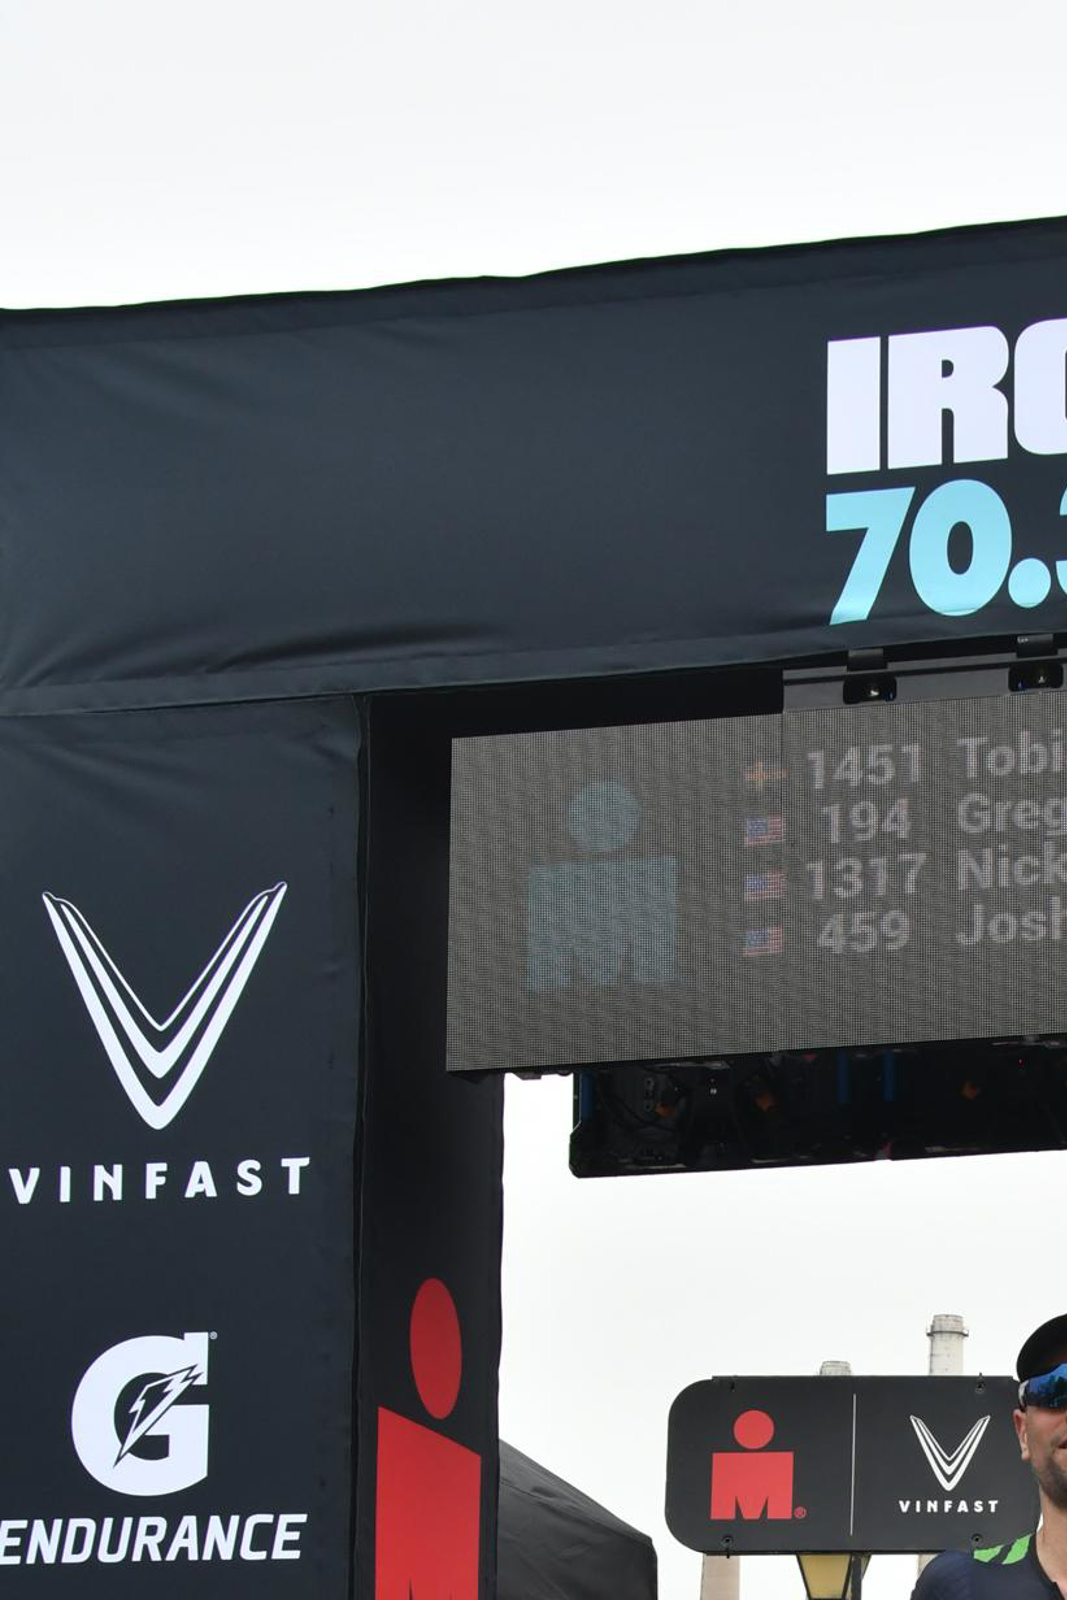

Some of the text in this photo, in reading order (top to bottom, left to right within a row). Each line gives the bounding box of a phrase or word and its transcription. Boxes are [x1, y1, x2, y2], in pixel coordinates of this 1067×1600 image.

[807, 742, 921, 790] 1451
[822, 798, 911, 844] 194
[806, 852, 927, 900] 1317
[817, 910, 911, 953] 459
[9, 1156, 310, 1204] VINFAST
[898, 1499, 999, 1513] VINFAST
[0, 1512, 308, 1565] ENDURANCE
